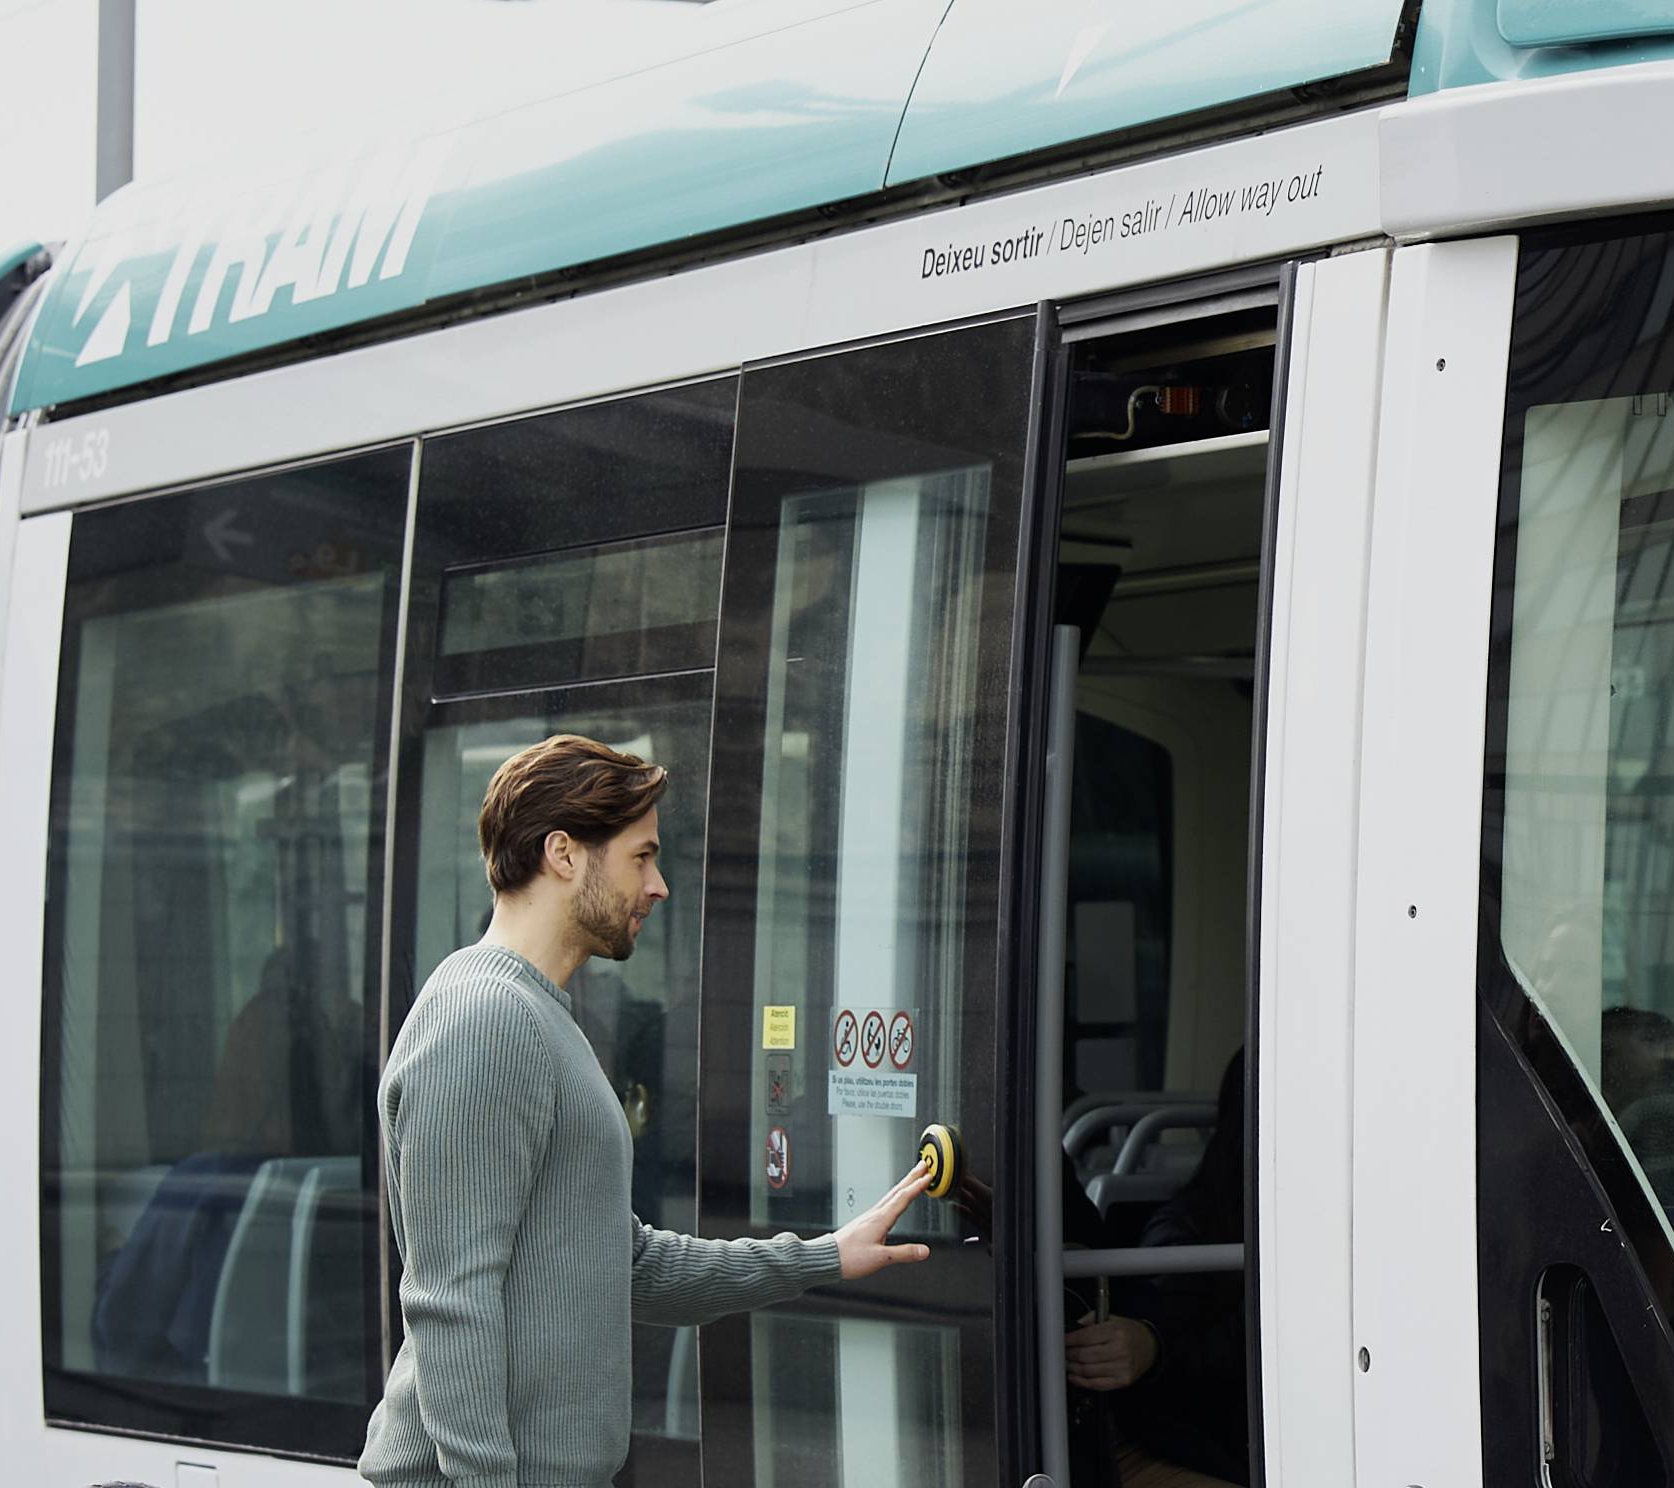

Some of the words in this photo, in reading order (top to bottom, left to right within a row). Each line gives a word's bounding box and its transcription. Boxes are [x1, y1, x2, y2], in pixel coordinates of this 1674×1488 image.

[146, 152, 444, 347] TRAM
[921, 242, 986, 280] Deixeu
[990, 224, 1045, 266] sortir
[1059, 213, 1115, 256] Dejen
[1120, 200, 1163, 239] salir
[1178, 187, 1235, 227] Allow
[1240, 180, 1282, 217] way
[1288, 164, 1324, 202] out
[43, 427, 110, 491] 111-53
